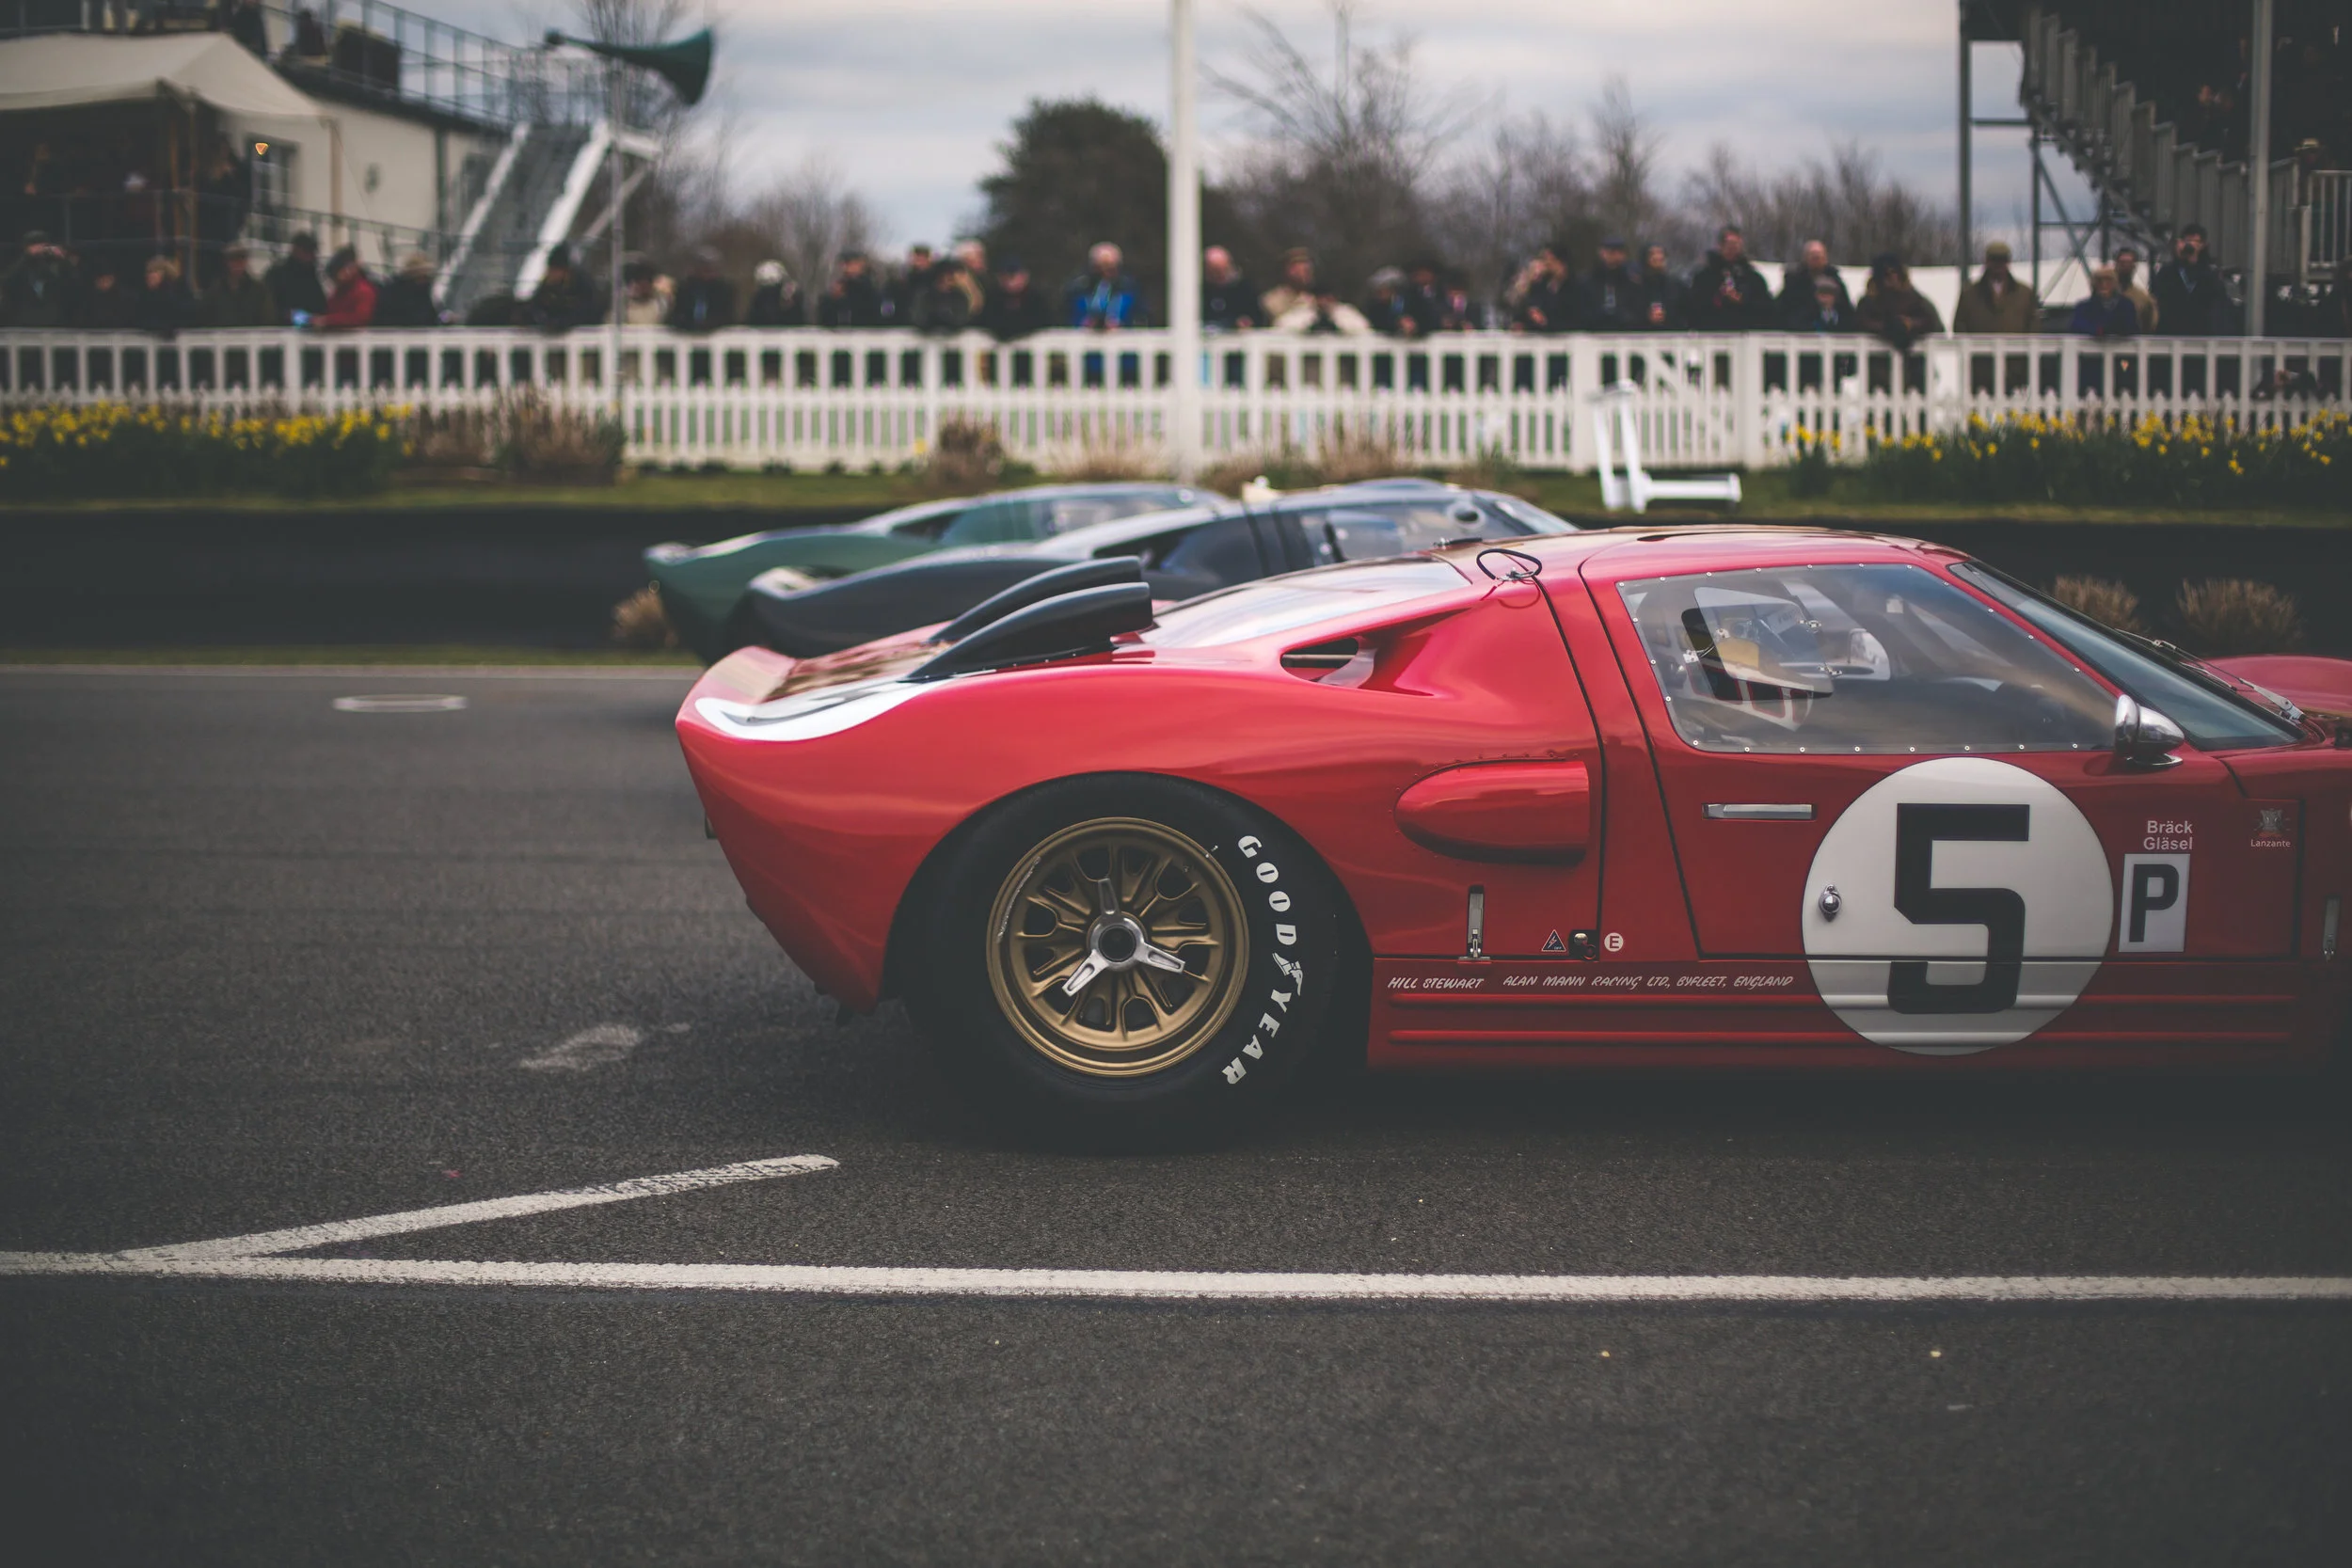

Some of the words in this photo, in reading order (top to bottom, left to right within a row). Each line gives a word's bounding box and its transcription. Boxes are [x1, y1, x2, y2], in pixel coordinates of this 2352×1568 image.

[2147, 820, 2194, 834] Bräck
[2143, 836, 2194, 850] Gläsel
[2250, 839, 2292, 847] Lanzante
[1887, 803, 2030, 1015] 5
[2129, 863, 2180, 942] P
[1221, 835, 1303, 1085] GOODYEAR
[1388, 976, 1418, 989] HILL
[1422, 977, 1485, 989] STEWART
[1502, 975, 1538, 987] ALAN
[1542, 975, 1586, 987] MANN
[1591, 975, 1643, 990] RACING
[1646, 975, 1671, 989] LTD.,
[1677, 975, 1727, 989] BYFLEET,
[1733, 975, 1794, 990] ENGLAND
